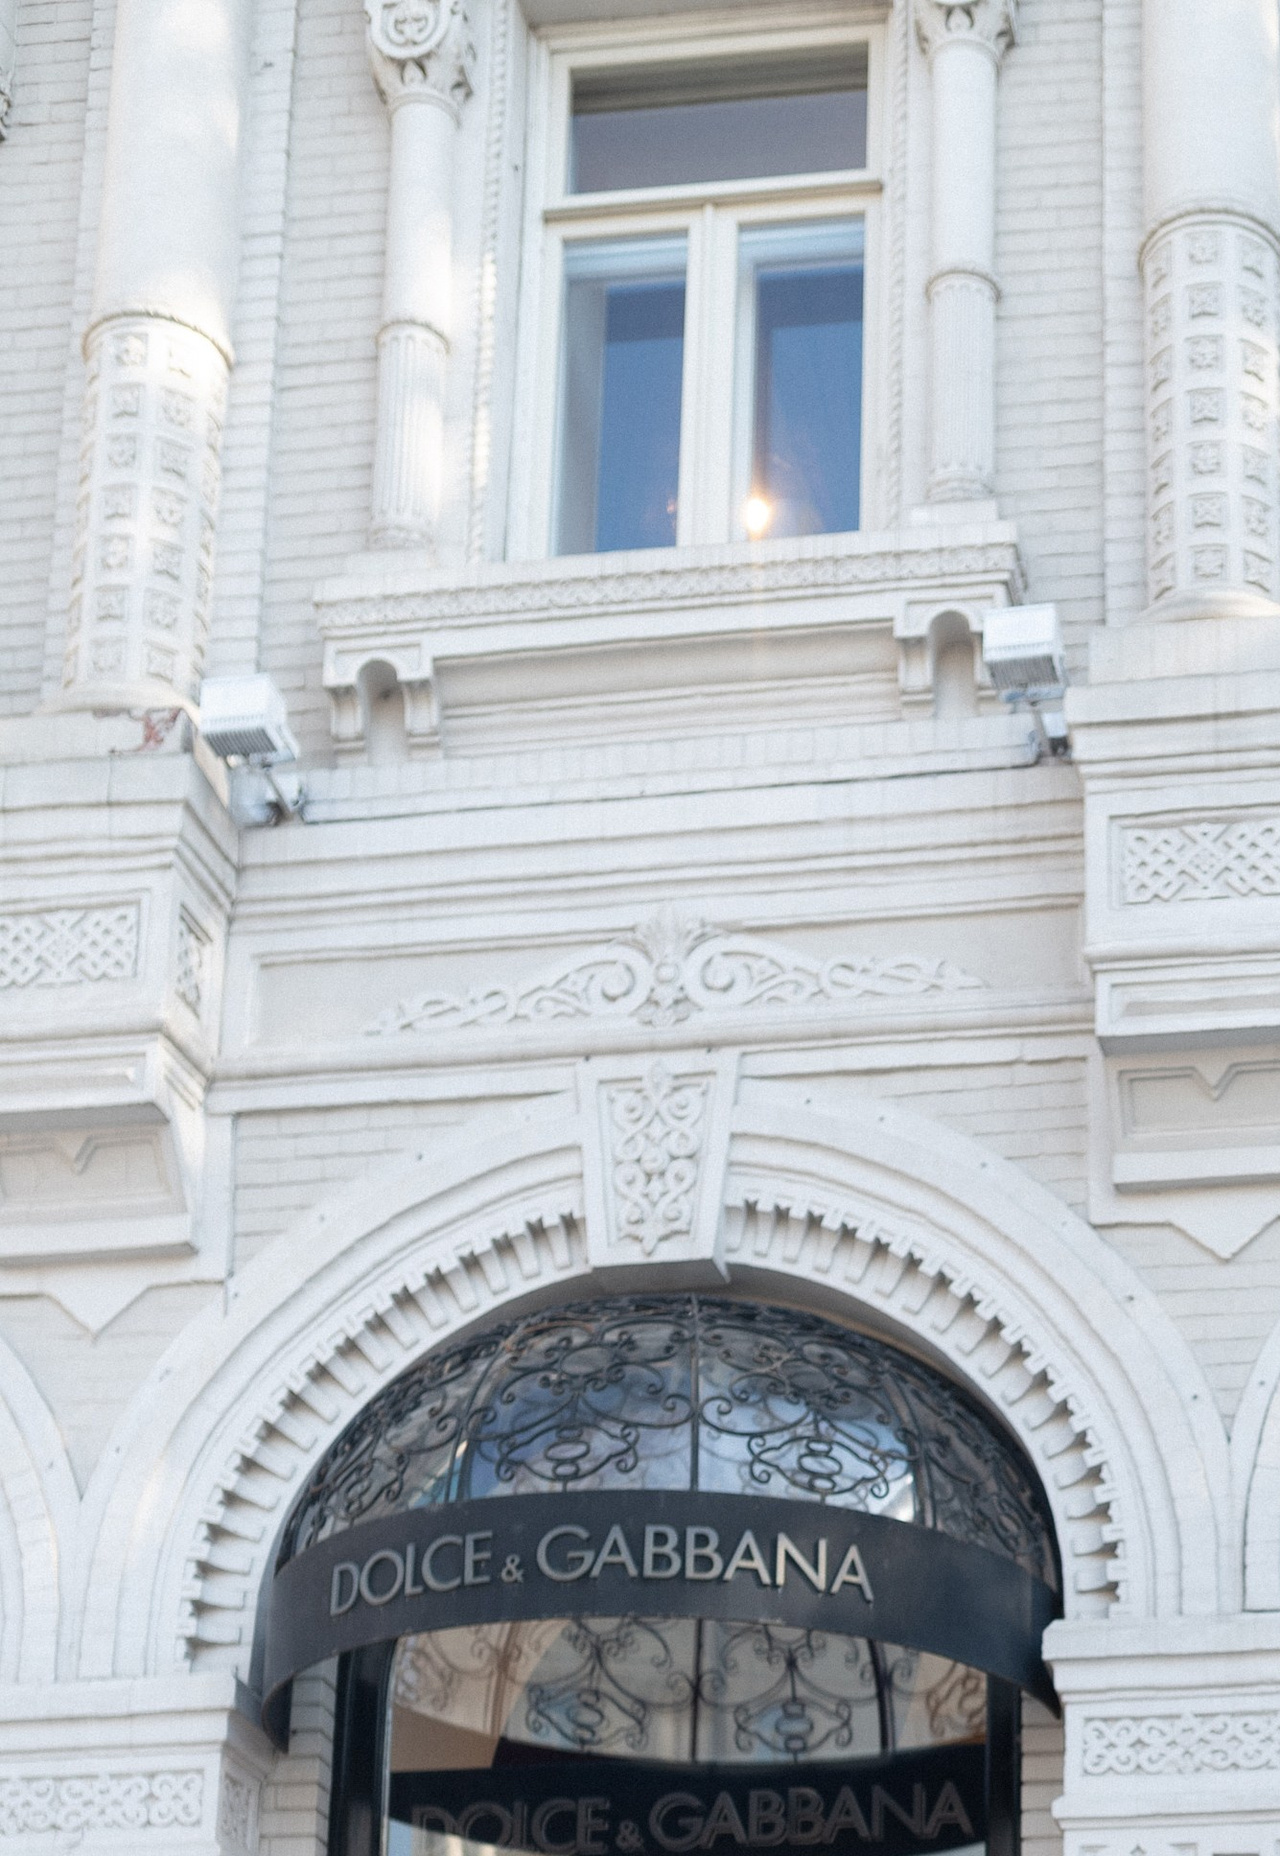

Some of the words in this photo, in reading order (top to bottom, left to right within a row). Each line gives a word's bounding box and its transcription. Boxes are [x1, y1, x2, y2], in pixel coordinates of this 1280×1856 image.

[330, 1530, 493, 1617] DOLCE
[500, 1553, 525, 1585] &
[536, 1522, 875, 1602] GABBANA
[615, 1819, 645, 1851] &
[648, 1779, 974, 1853] GABBANA
